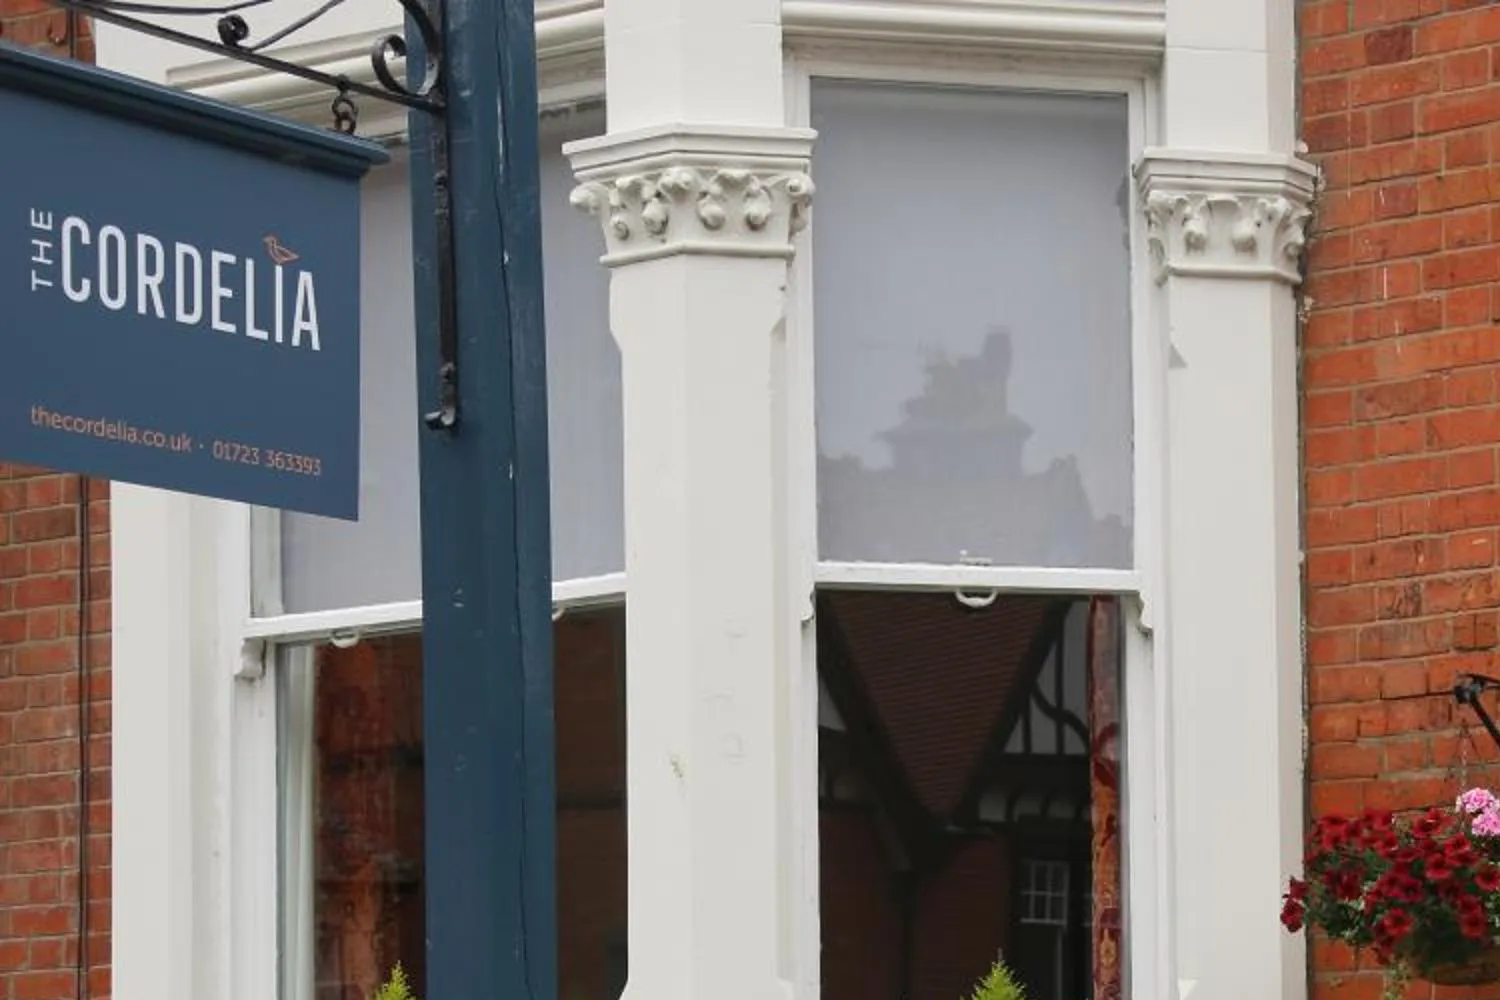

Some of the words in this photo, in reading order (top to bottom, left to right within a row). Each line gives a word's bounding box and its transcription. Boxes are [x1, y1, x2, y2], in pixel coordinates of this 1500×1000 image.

[31, 207, 53, 291] THE
[61, 215, 321, 351] CORDELIA
[31, 405, 192, 452] thecordelia.co.uk
[213, 440, 260, 466] 01723
